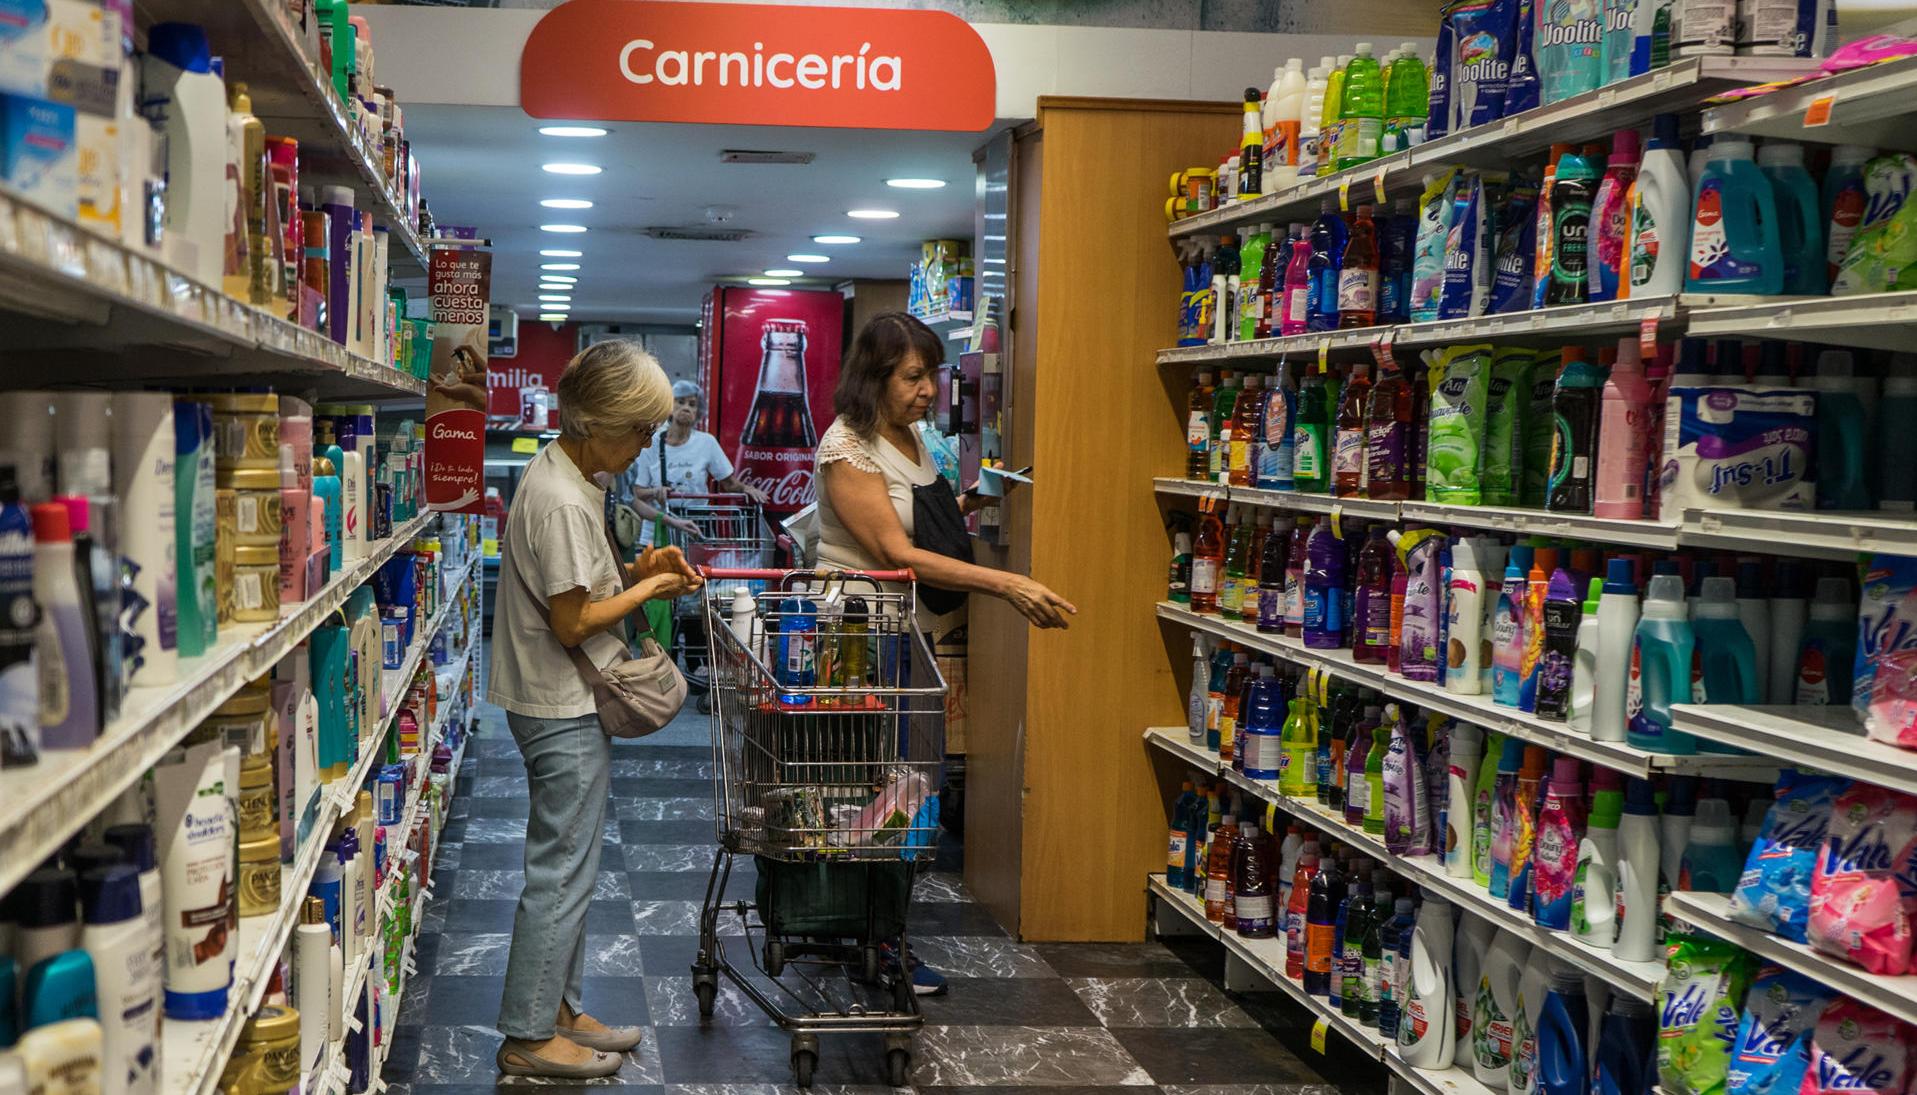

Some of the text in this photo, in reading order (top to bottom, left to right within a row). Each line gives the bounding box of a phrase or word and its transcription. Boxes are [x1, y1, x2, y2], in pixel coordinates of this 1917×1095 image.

[619, 39, 902, 91] Carnicería
[435, 260, 479, 271] Lo que te
[435, 270, 482, 279] gusta más
[434, 280, 479, 295] ahora
[434, 296, 483, 310] cuesta
[434, 310, 483, 323] menos
[487, 368, 543, 388] milia
[432, 423, 478, 440] Gama
[744, 451, 773, 461] SABOR
[432, 472, 479, 485] siempre!
[1819, 1043, 1893, 1090] Vale
